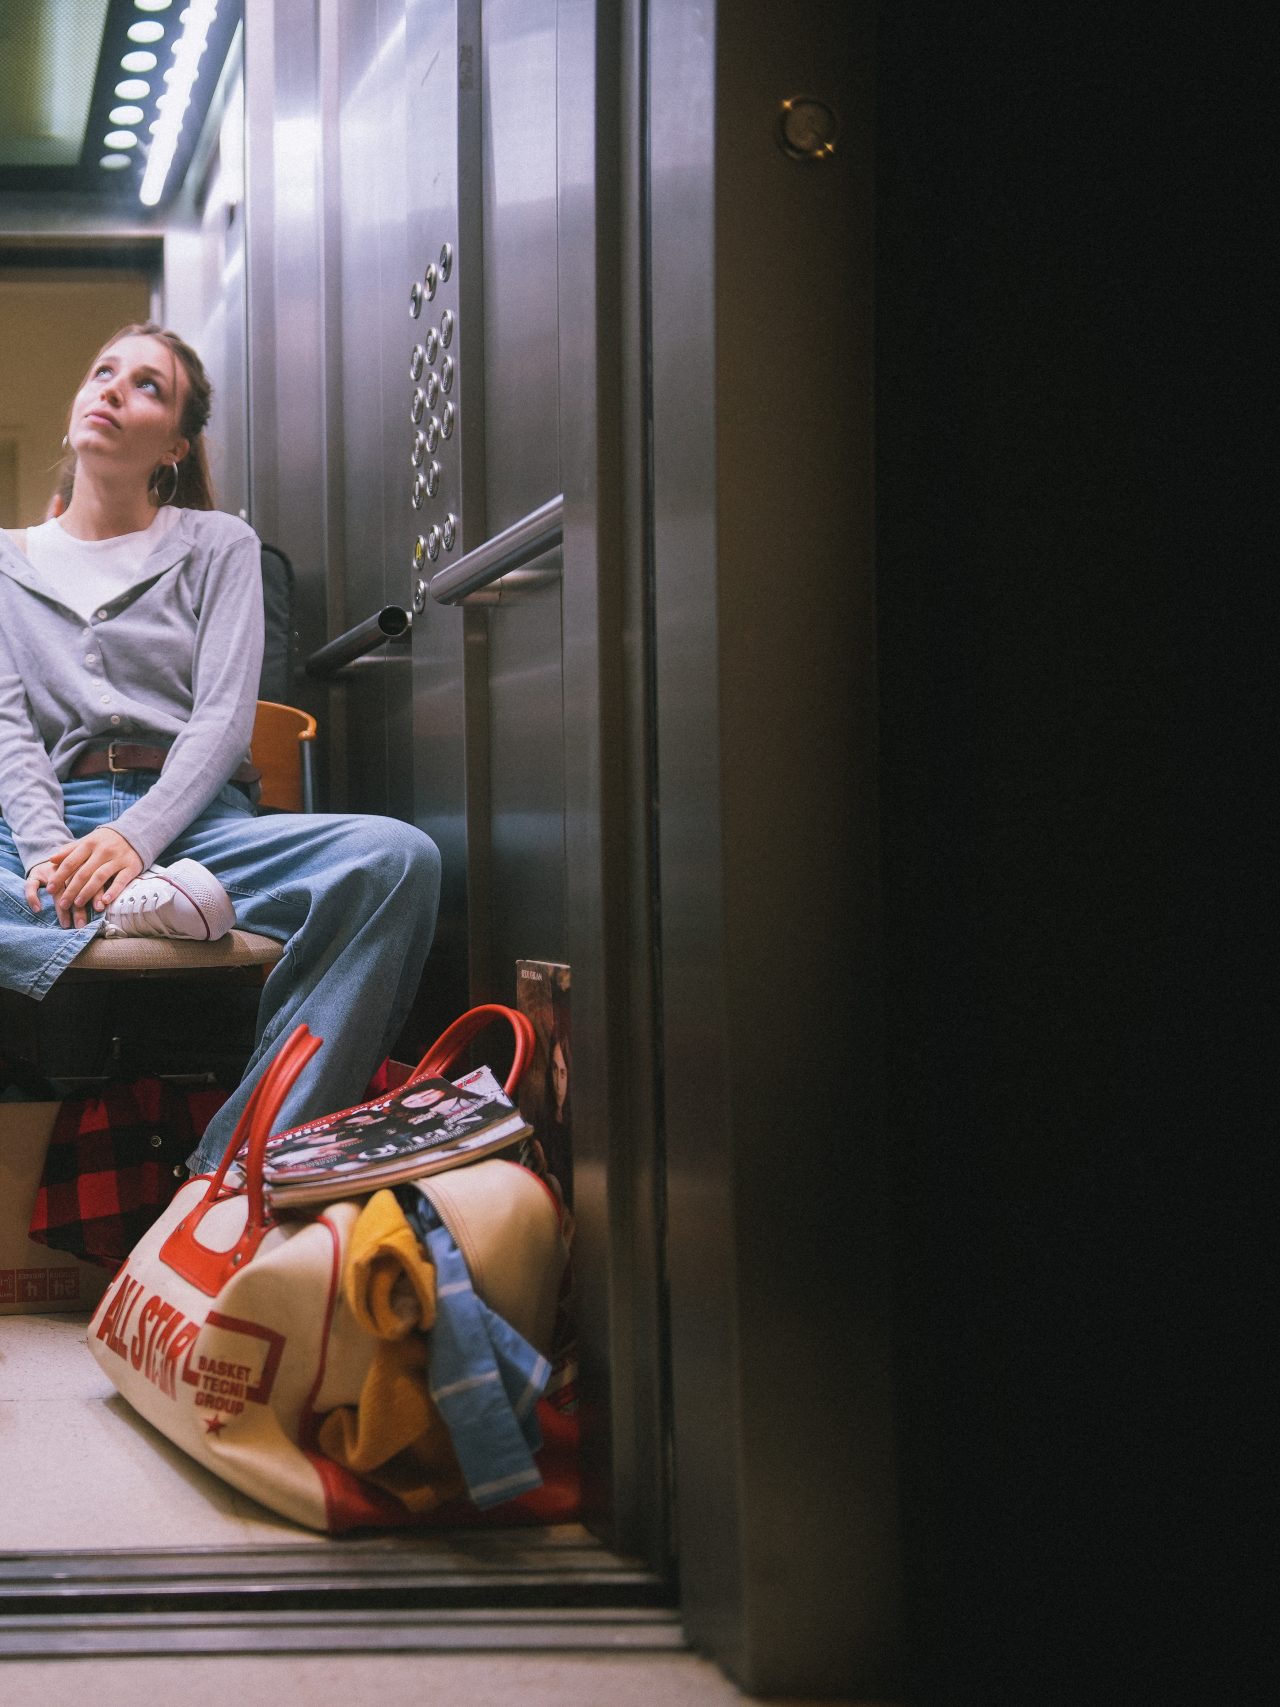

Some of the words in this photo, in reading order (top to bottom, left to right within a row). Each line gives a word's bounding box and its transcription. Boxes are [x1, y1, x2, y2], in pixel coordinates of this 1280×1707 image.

[96, 1273, 145, 1360] ALL
[130, 1295, 202, 1402] STAR
[198, 1354, 252, 1382] BASKET
[194, 1391, 246, 1415] GROUP
